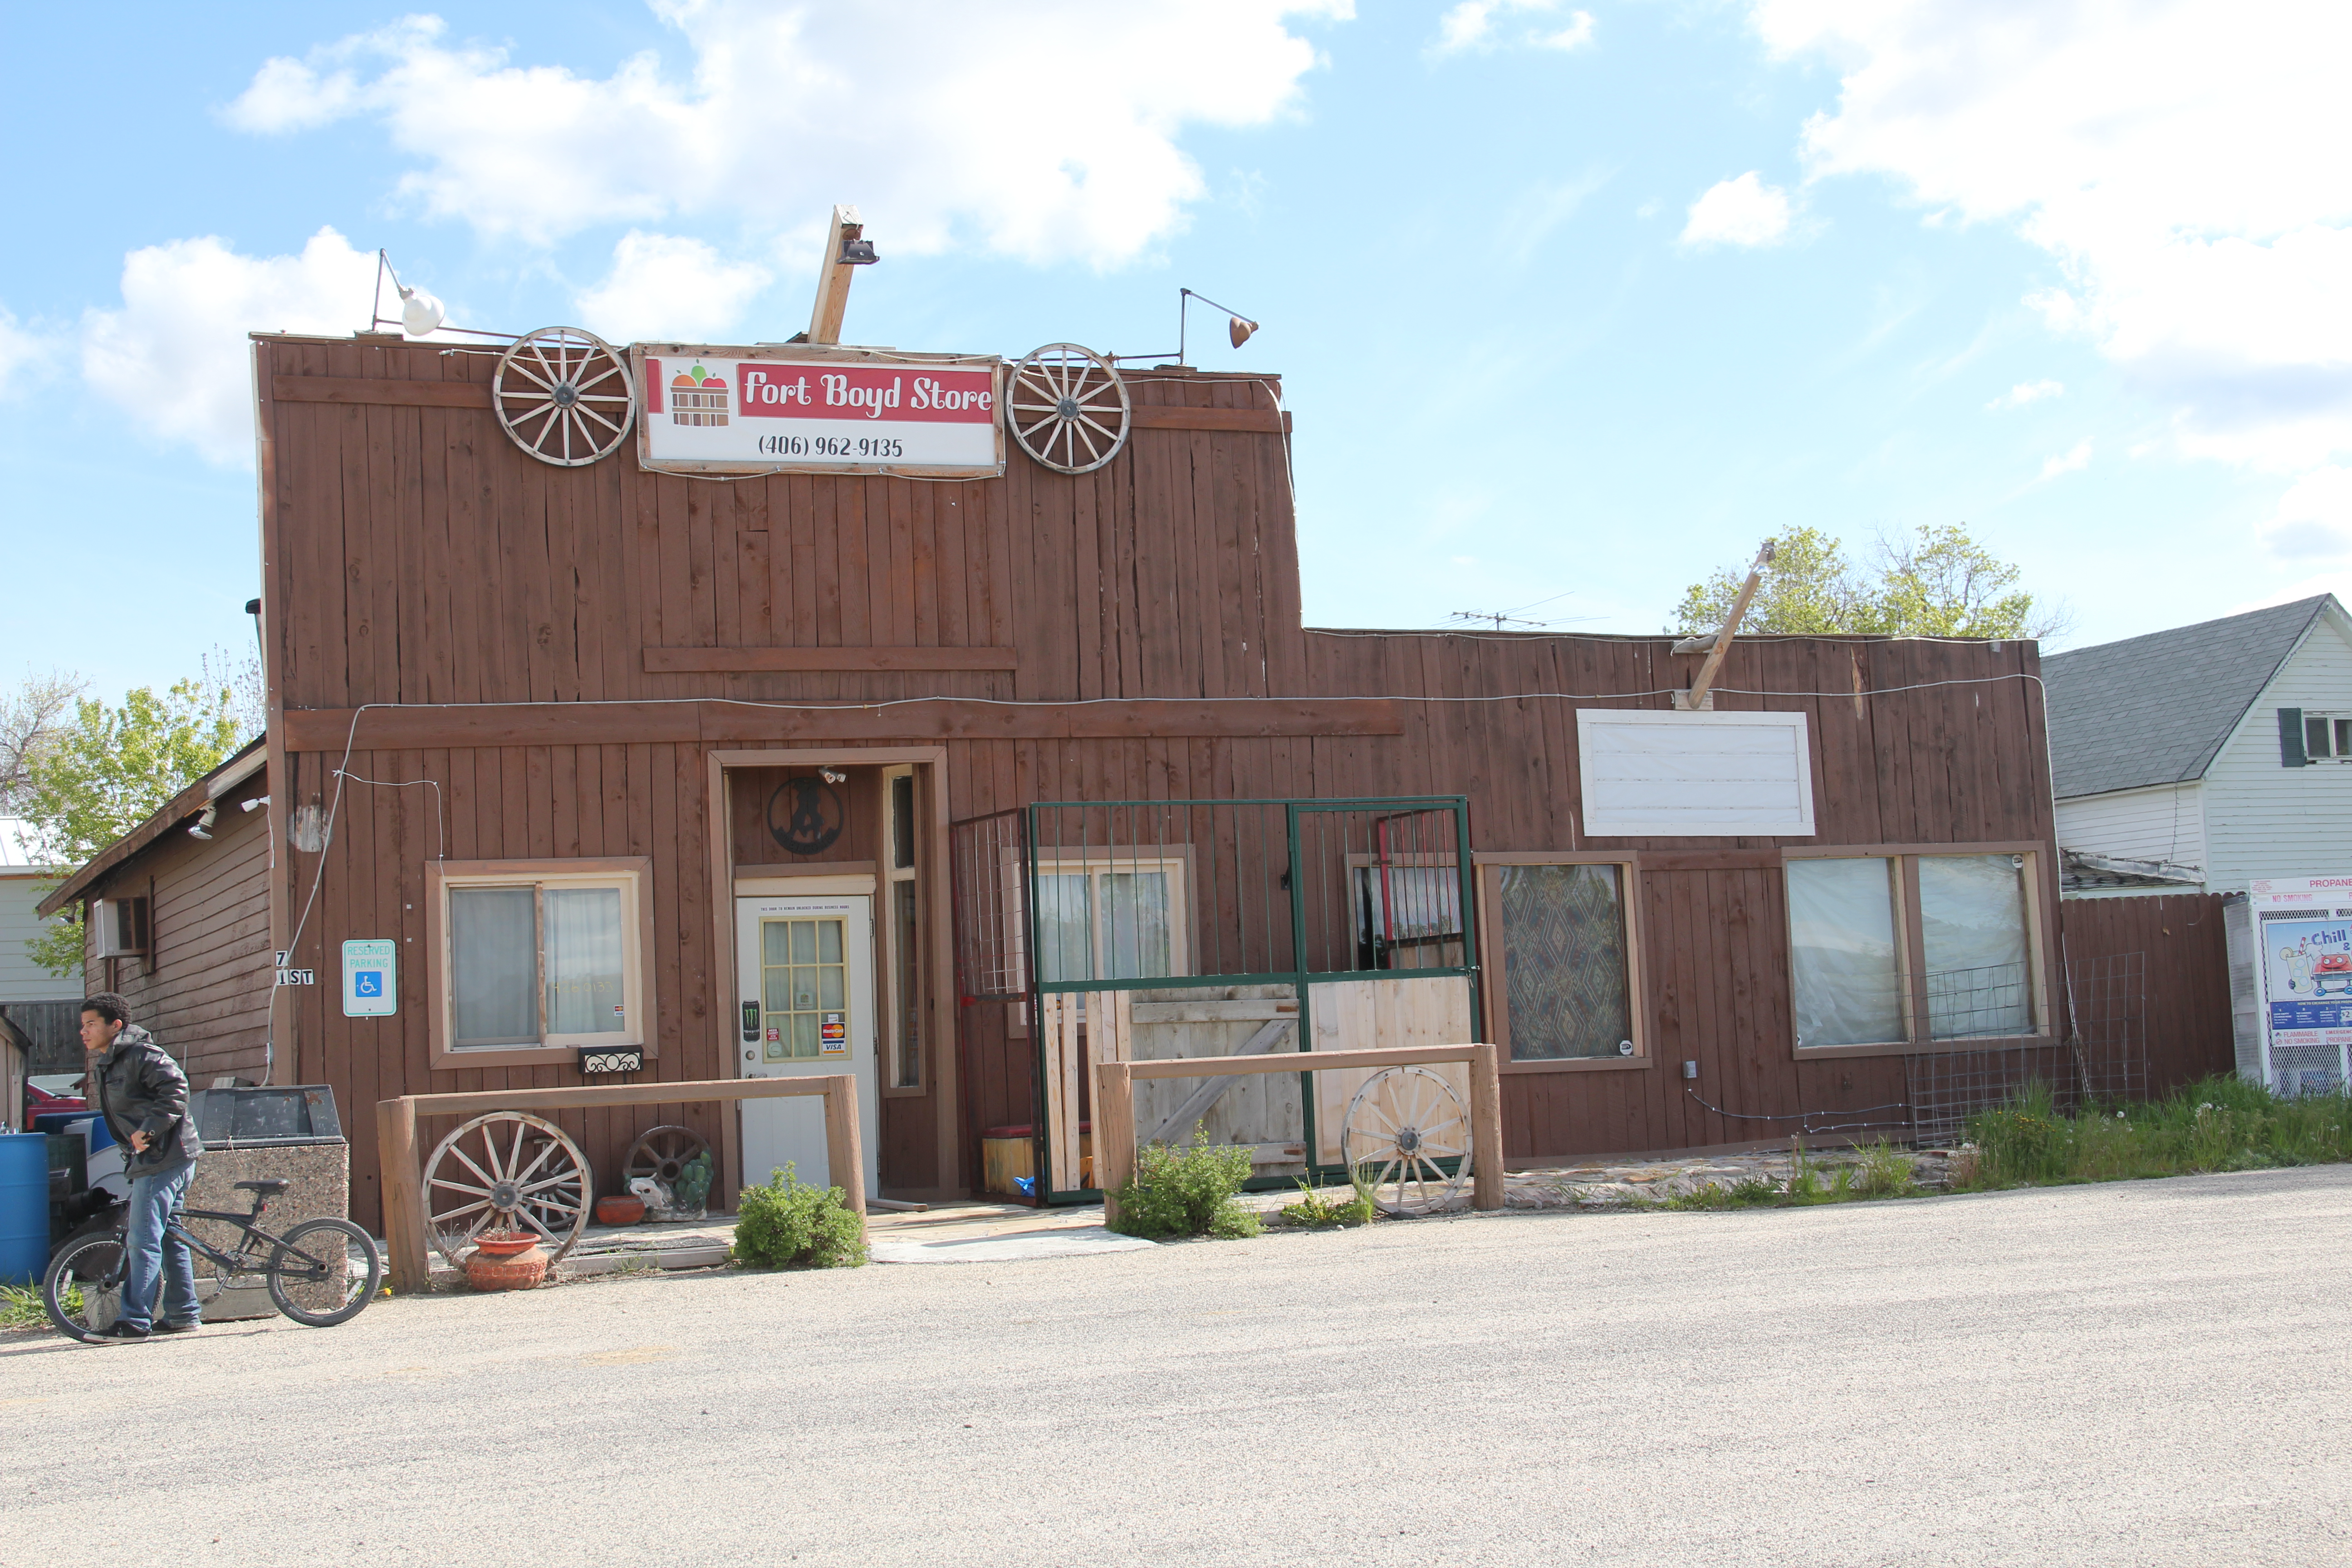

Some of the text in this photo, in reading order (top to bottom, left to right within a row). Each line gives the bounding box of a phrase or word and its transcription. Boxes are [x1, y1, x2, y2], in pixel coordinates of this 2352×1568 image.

[820, 374, 901, 419] Boyd
[910, 377, 992, 411] Store
[759, 435, 902, 457] (406) 962-9135
[2309, 878, 2352, 887] PROPANE
[2283, 894, 2313, 902] SMOKING
[2311, 929, 2346, 946] Chill
[348, 946, 390, 955] RESERVED
[2343, 942, 2350, 951] &
[277, 952, 287, 965] 7
[350, 958, 388, 968] PARKING
